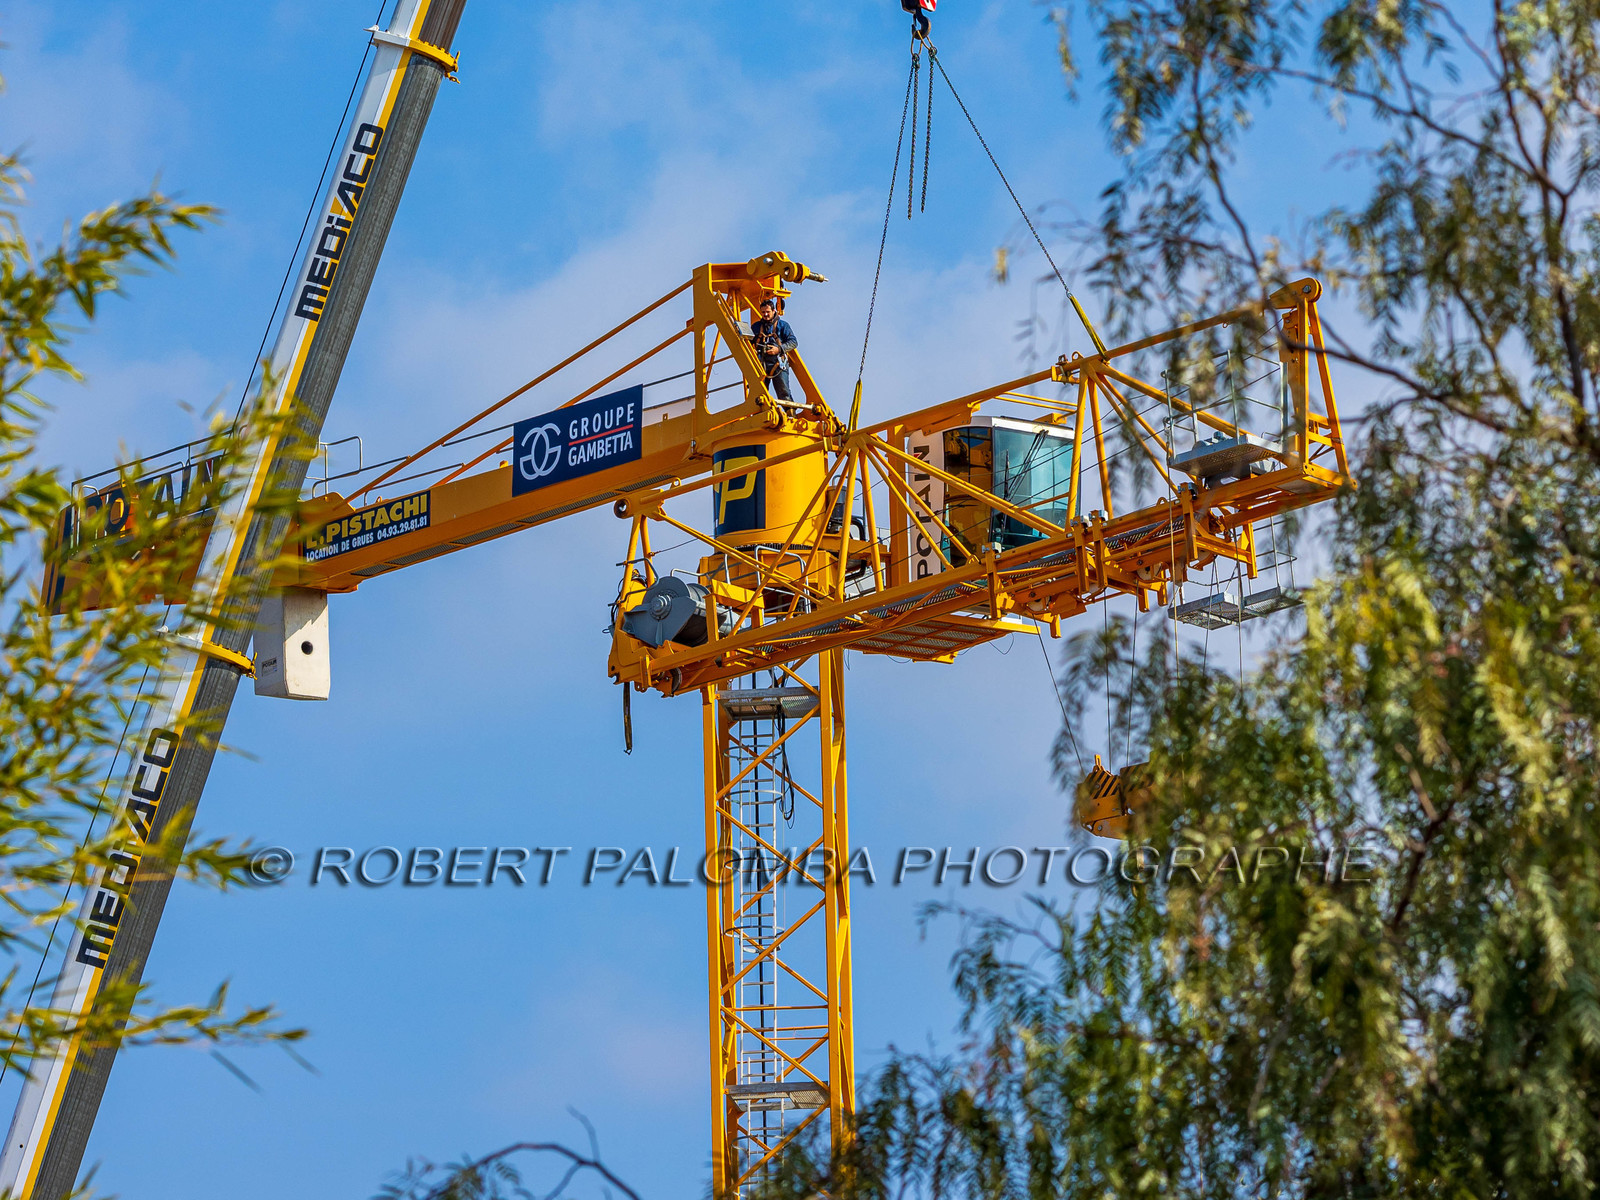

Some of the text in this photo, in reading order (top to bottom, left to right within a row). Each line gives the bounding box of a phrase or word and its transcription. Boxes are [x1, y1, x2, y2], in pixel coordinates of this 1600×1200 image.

[569, 403, 635, 439] GROUPE
[568, 431, 633, 466] GAMBETTA
[307, 515, 428, 562] LOCATION DE GRUES 04.93.29.81.81
